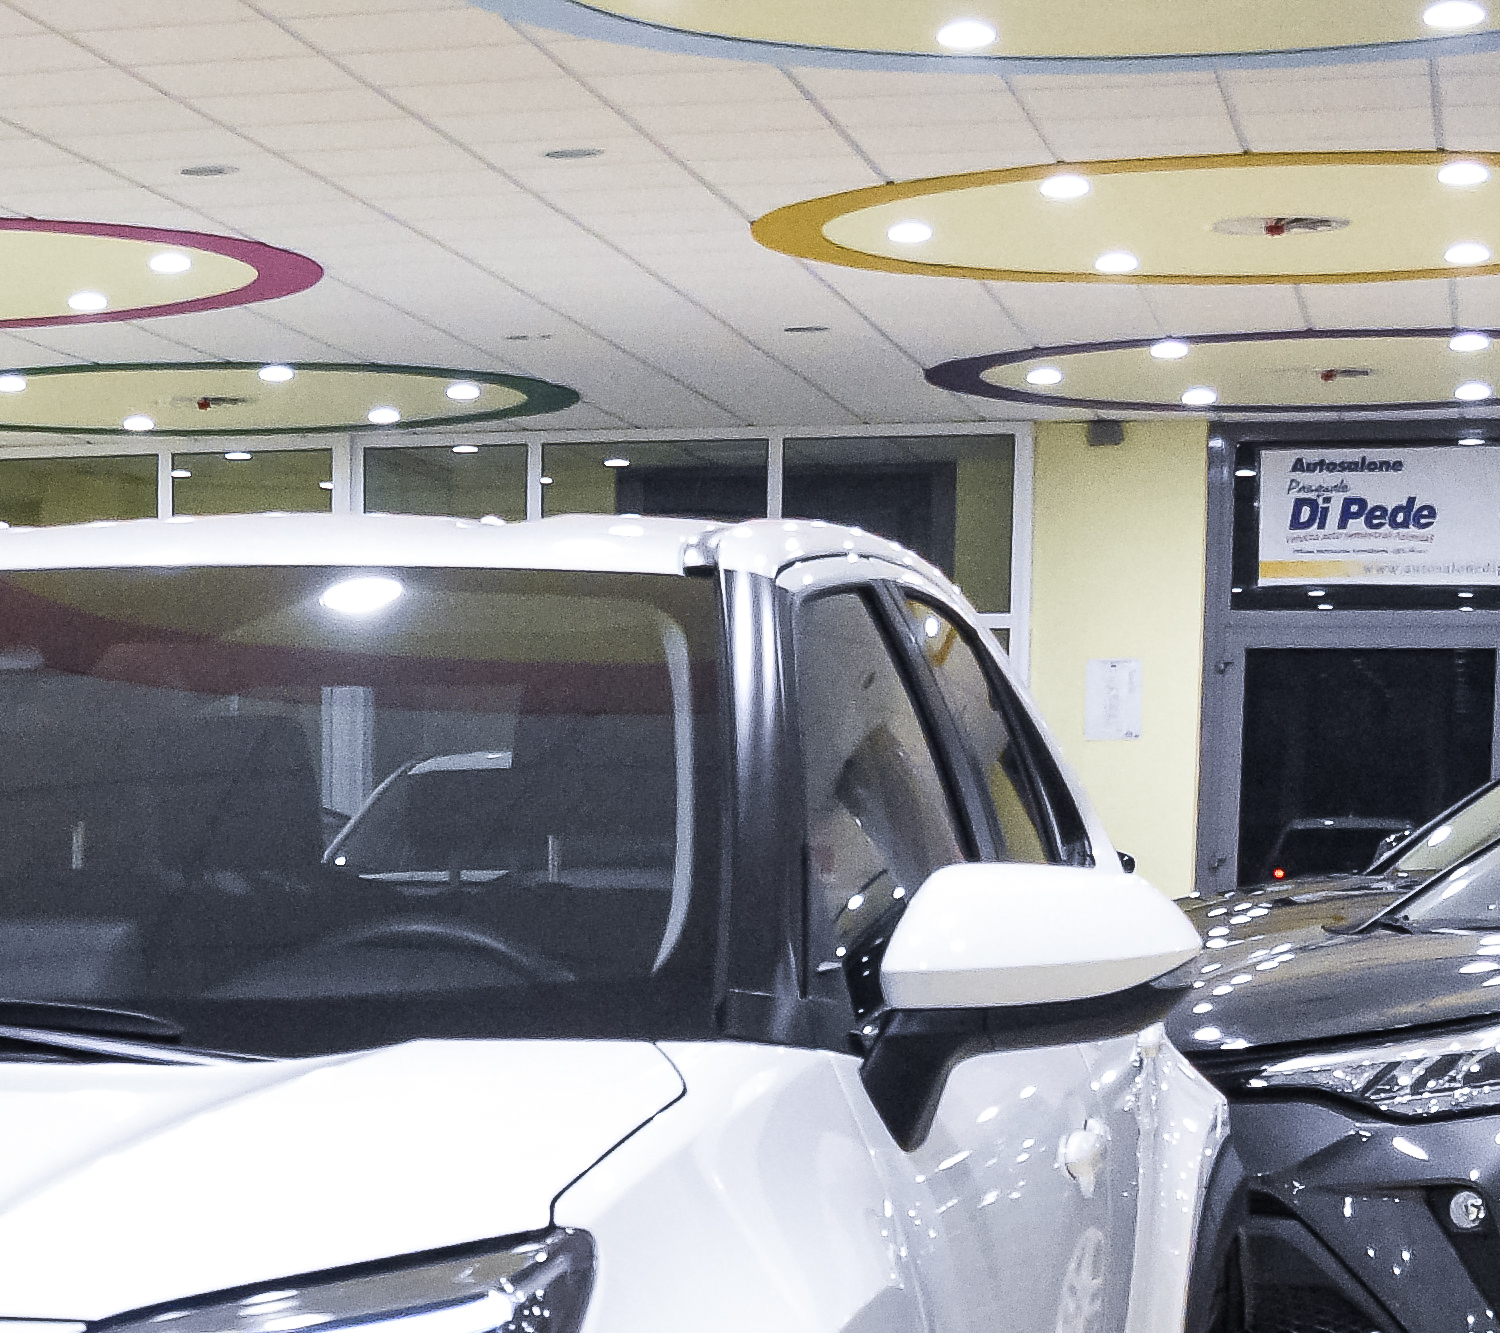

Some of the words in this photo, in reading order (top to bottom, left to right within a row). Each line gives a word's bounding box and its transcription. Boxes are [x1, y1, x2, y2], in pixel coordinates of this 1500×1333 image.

[1290, 455, 1404, 473] Autosalone
[1288, 496, 1332, 531] Di
[1337, 495, 1438, 531] Pede
